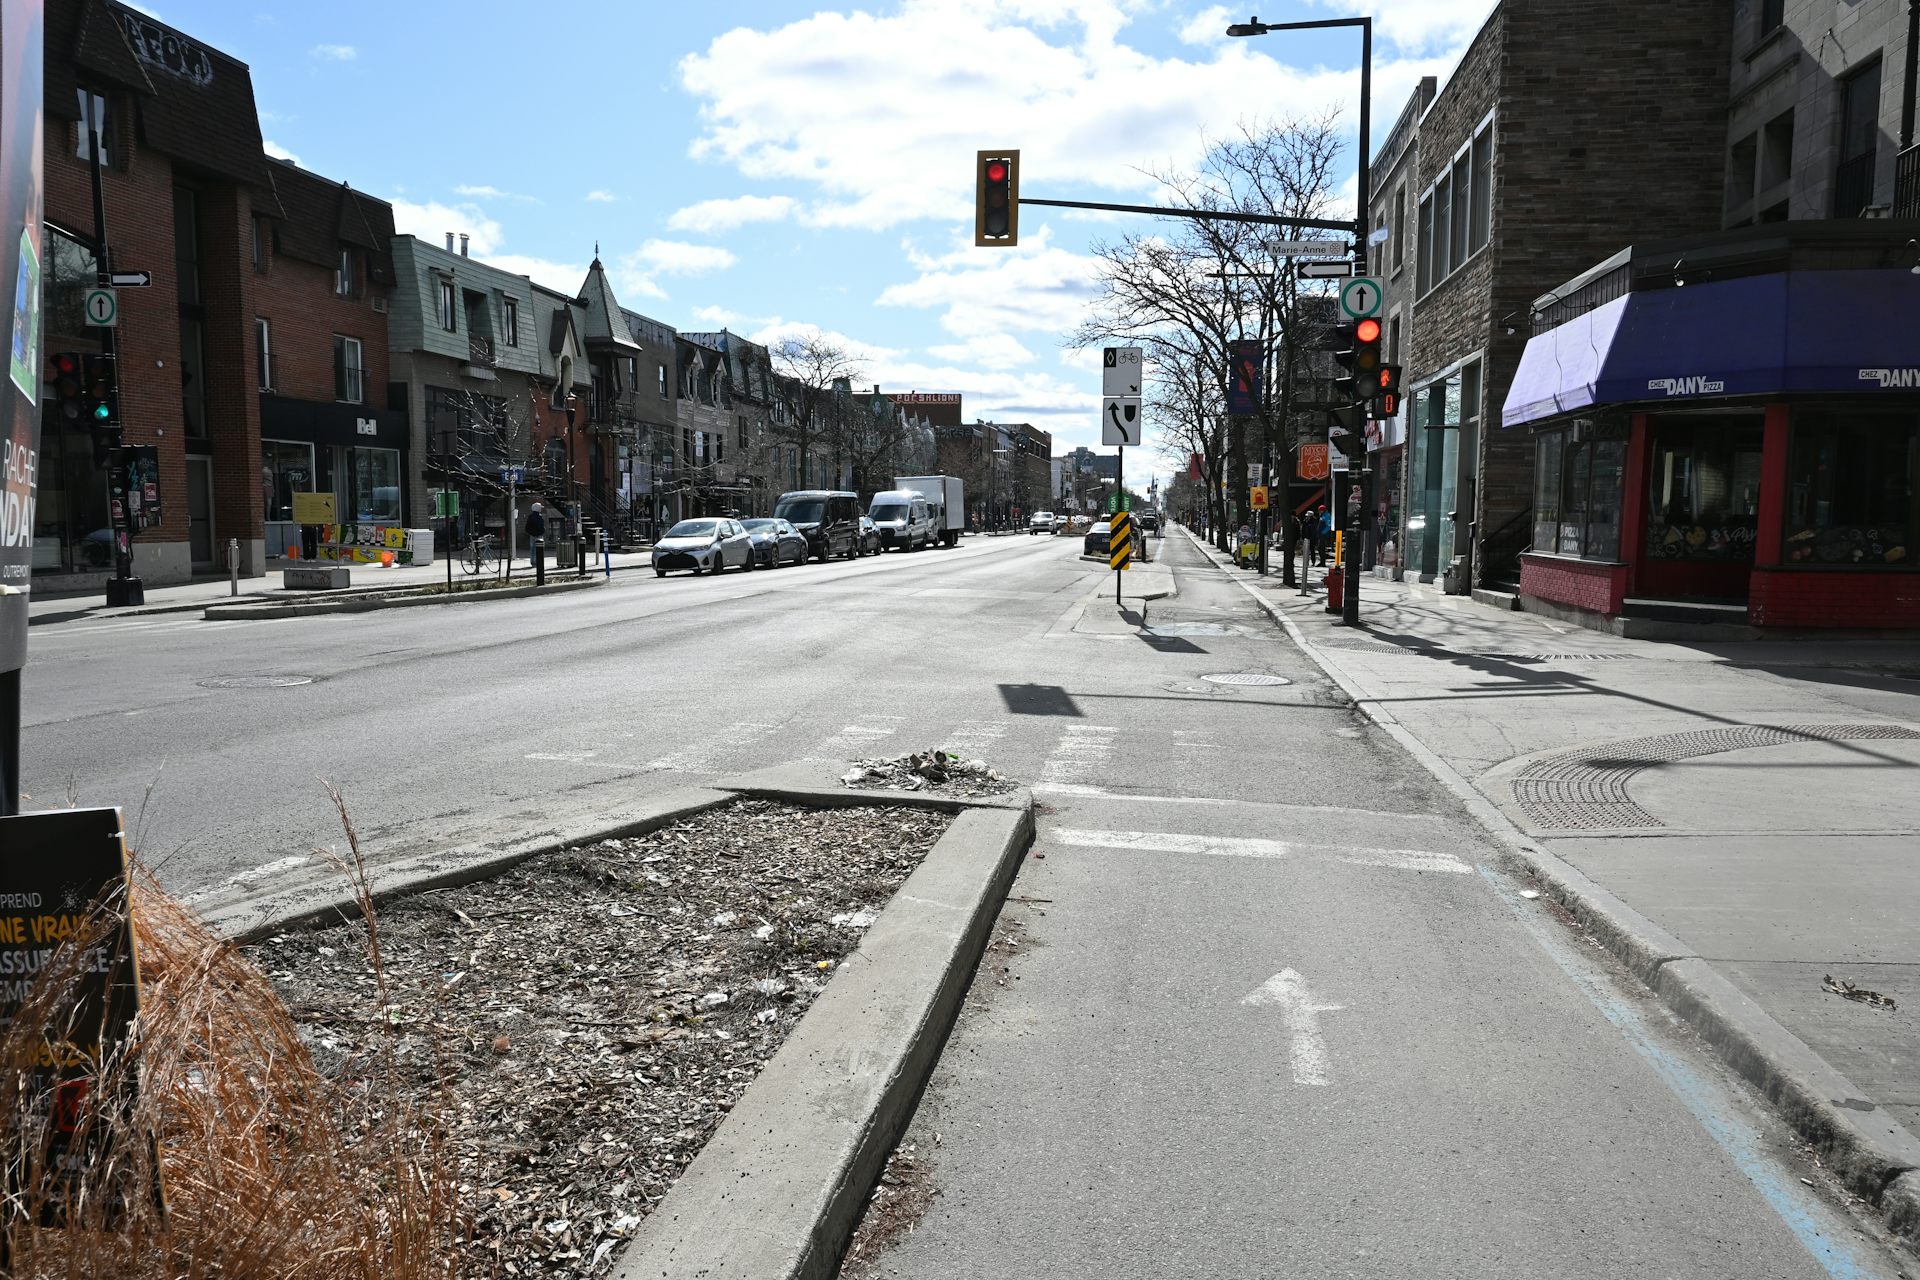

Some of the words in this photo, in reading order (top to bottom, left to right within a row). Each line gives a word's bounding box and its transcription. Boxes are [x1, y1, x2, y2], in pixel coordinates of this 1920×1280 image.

[1272, 246, 1326, 254] Marie-Anne
[1649, 380, 1665, 388] CHEZ
[1666, 376, 1706, 395] DANY
[1703, 383, 1722, 391] PIZZA
[1860, 370, 1878, 378] CHEZ
[1880, 368, 1920, 387] DANY
[357, 417, 377, 435] Bell
[2, 439, 37, 488] RACHEL
